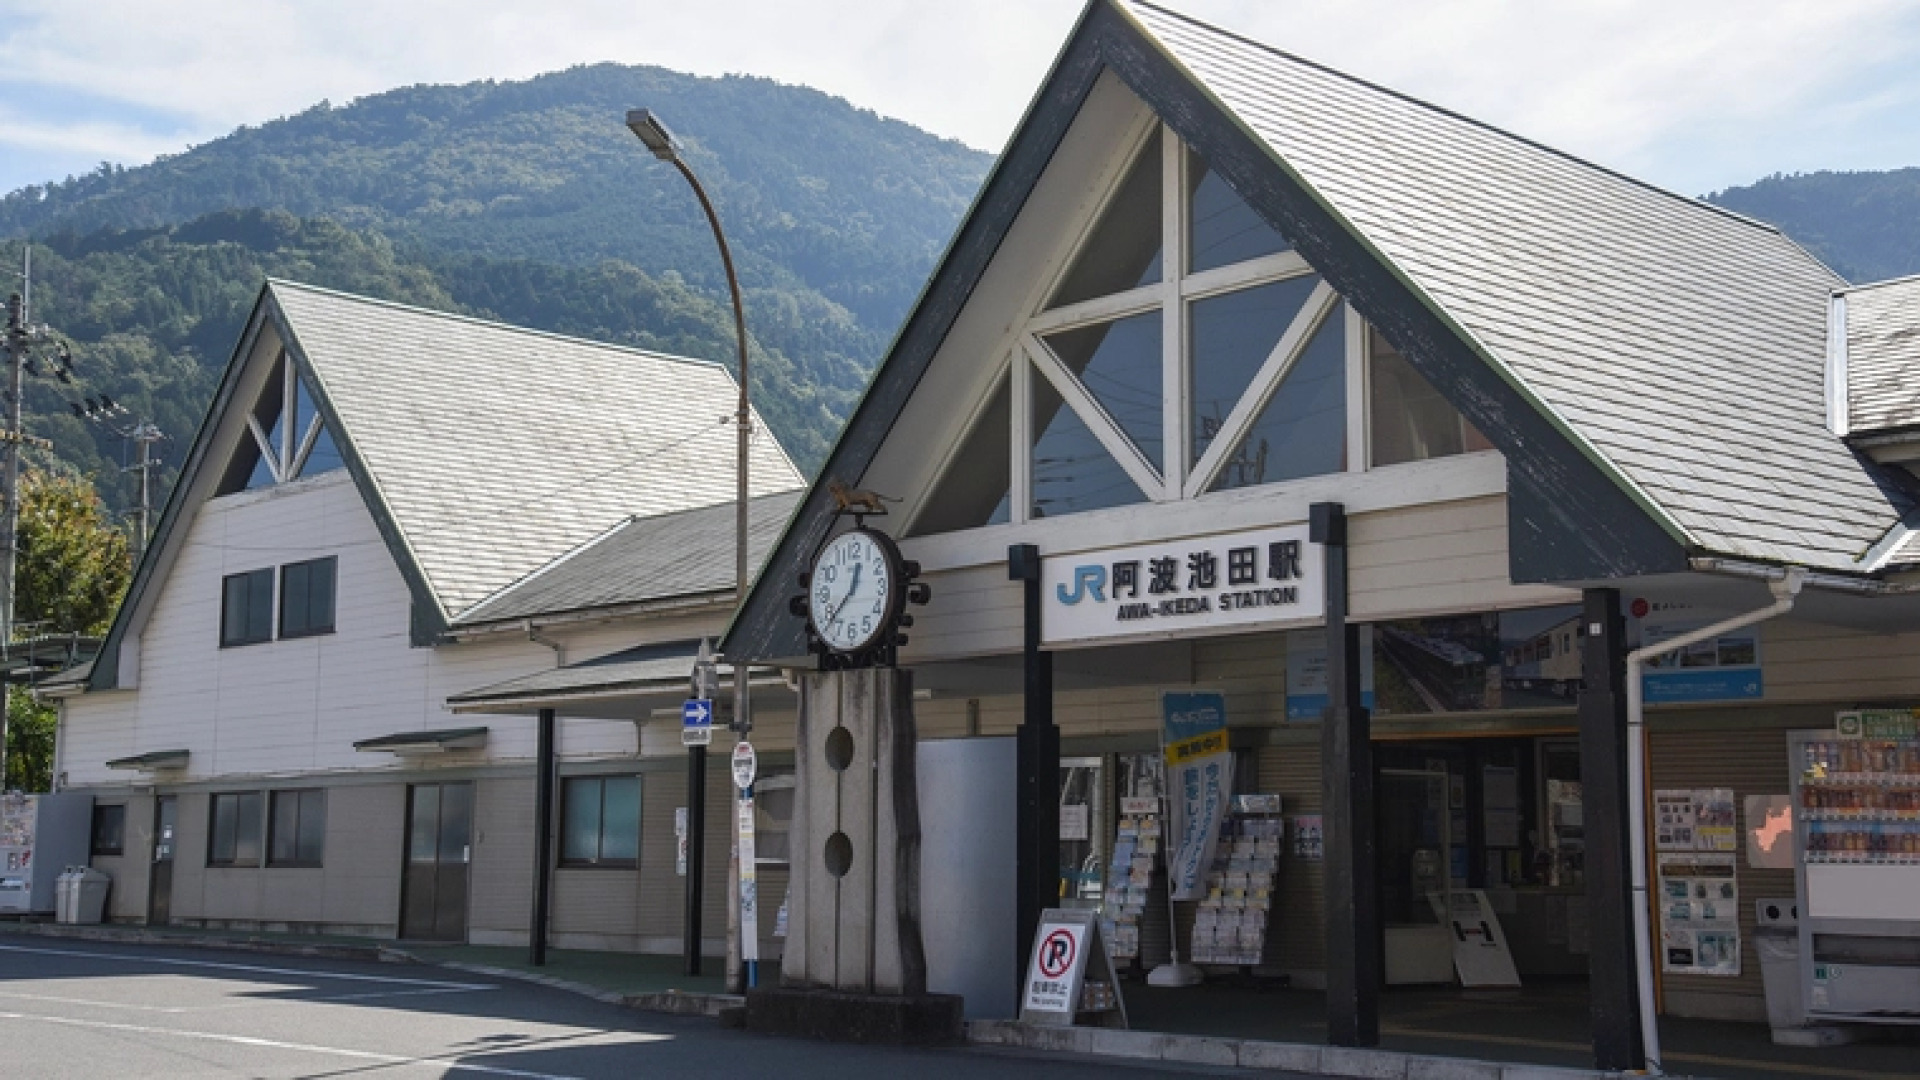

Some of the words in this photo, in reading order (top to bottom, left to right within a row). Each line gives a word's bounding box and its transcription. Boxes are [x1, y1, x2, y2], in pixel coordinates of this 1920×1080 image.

[847, 542, 861, 559] 12
[1112, 540, 1303, 598] 阿波池田駅
[1056, 564, 1107, 606] JR
[1116, 595, 1212, 621] AWA-IKEDA
[1218, 585, 1299, 611] STATION
[848, 623, 858, 639] 6
[861, 616, 871, 633] 5
